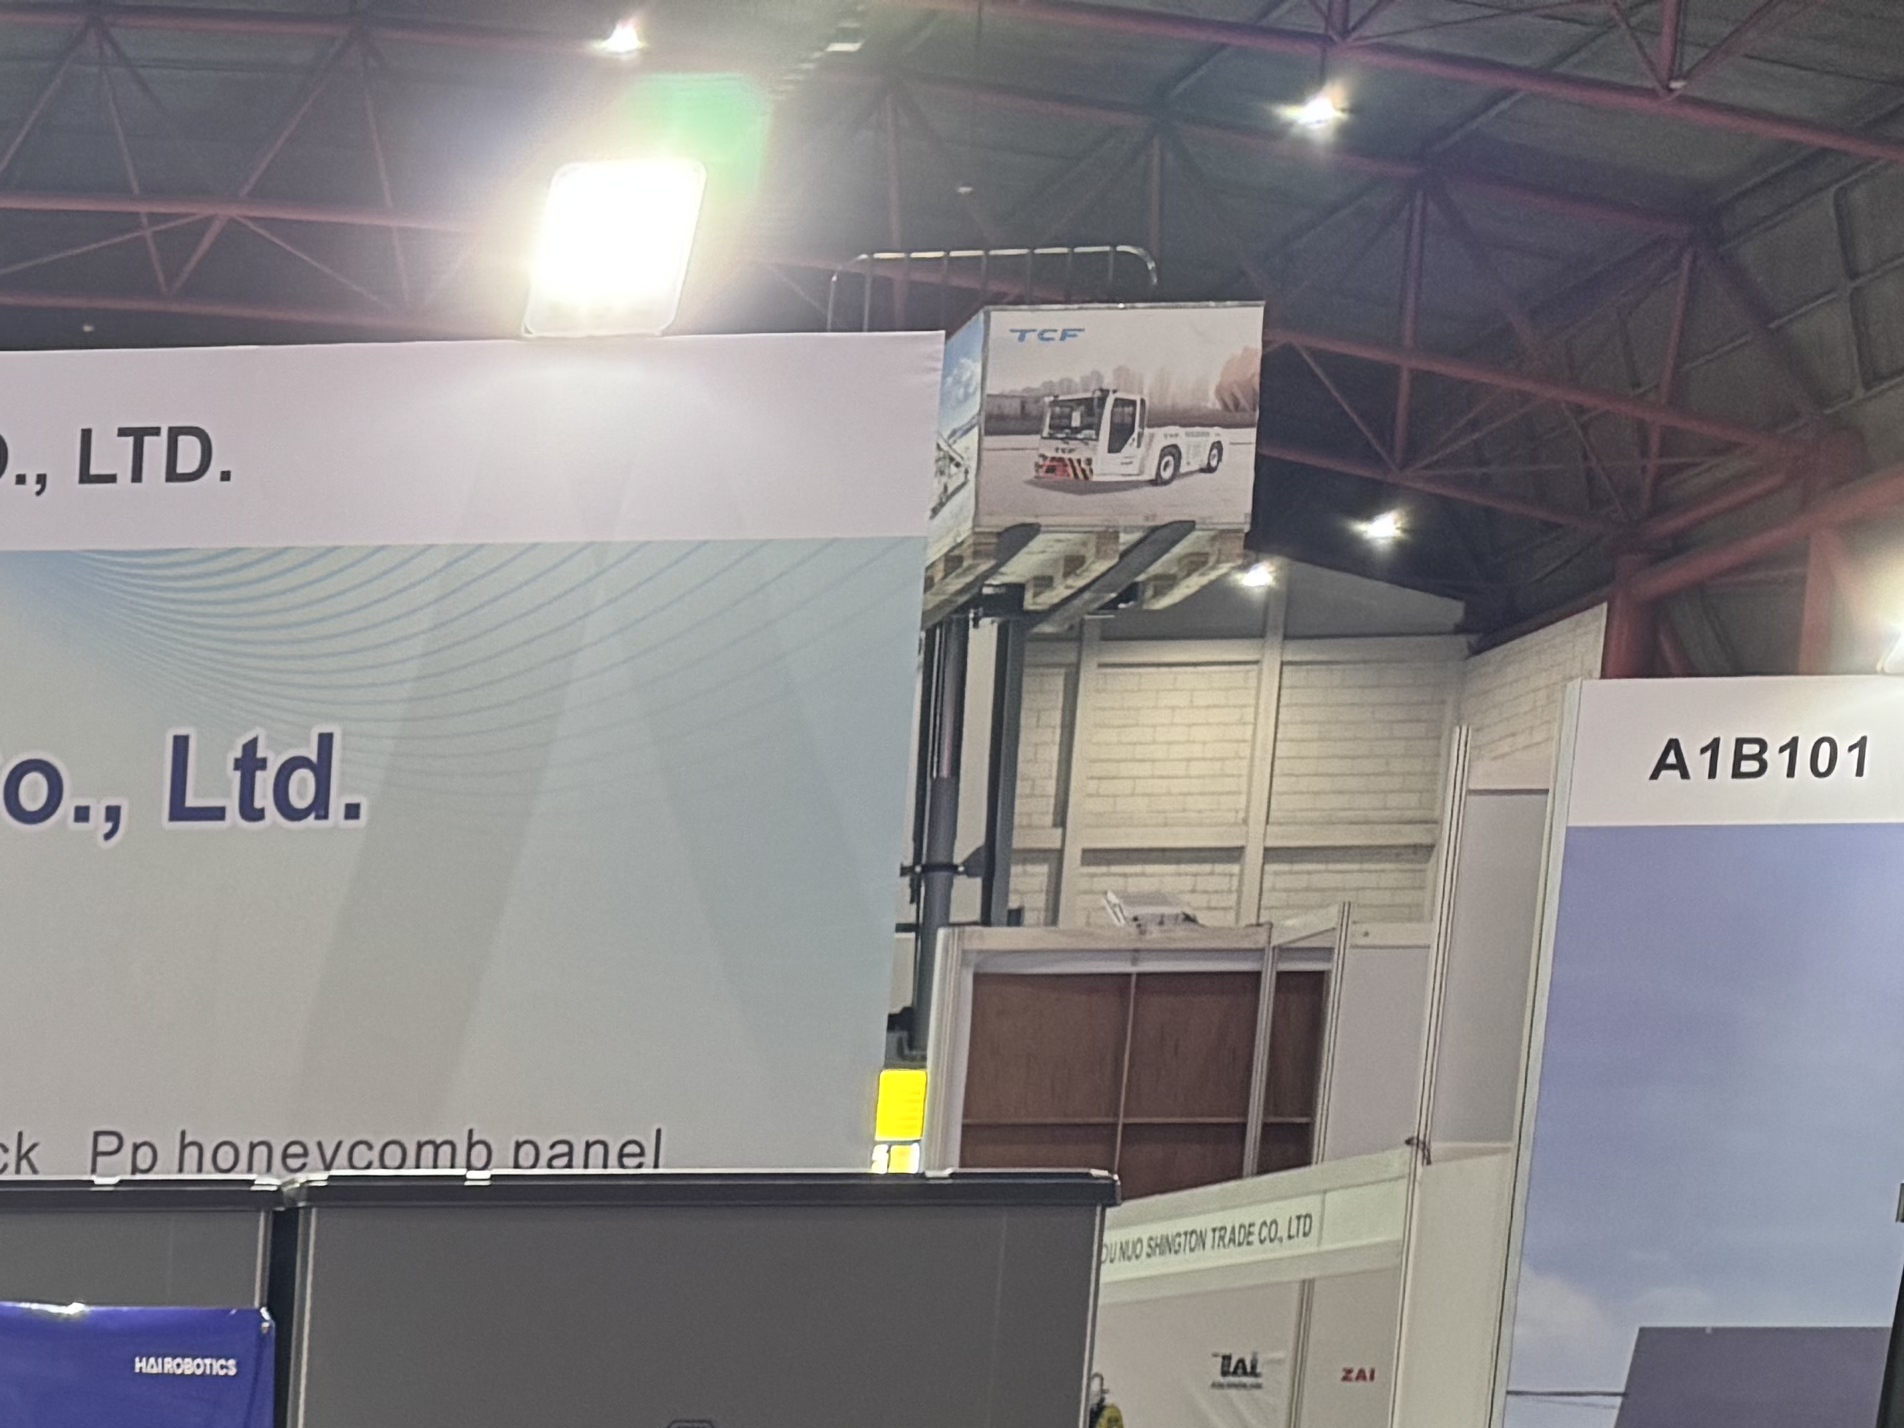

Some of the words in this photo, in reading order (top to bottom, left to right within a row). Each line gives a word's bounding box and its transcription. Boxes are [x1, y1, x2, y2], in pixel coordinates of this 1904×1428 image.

[1008, 327, 1086, 343] TCF
[75, 424, 234, 486] LTD.
[165, 729, 364, 827] Ltd.
[1648, 734, 1870, 782] A1B101
[177, 1128, 494, 1174] honeycomb
[513, 1128, 663, 1172] panel
[1145, 1228, 1207, 1259] SHINGTON
[1211, 1221, 1255, 1250] TRADE
[1287, 1213, 1313, 1241] LTD
[1340, 1366, 1376, 1383] ZAI
